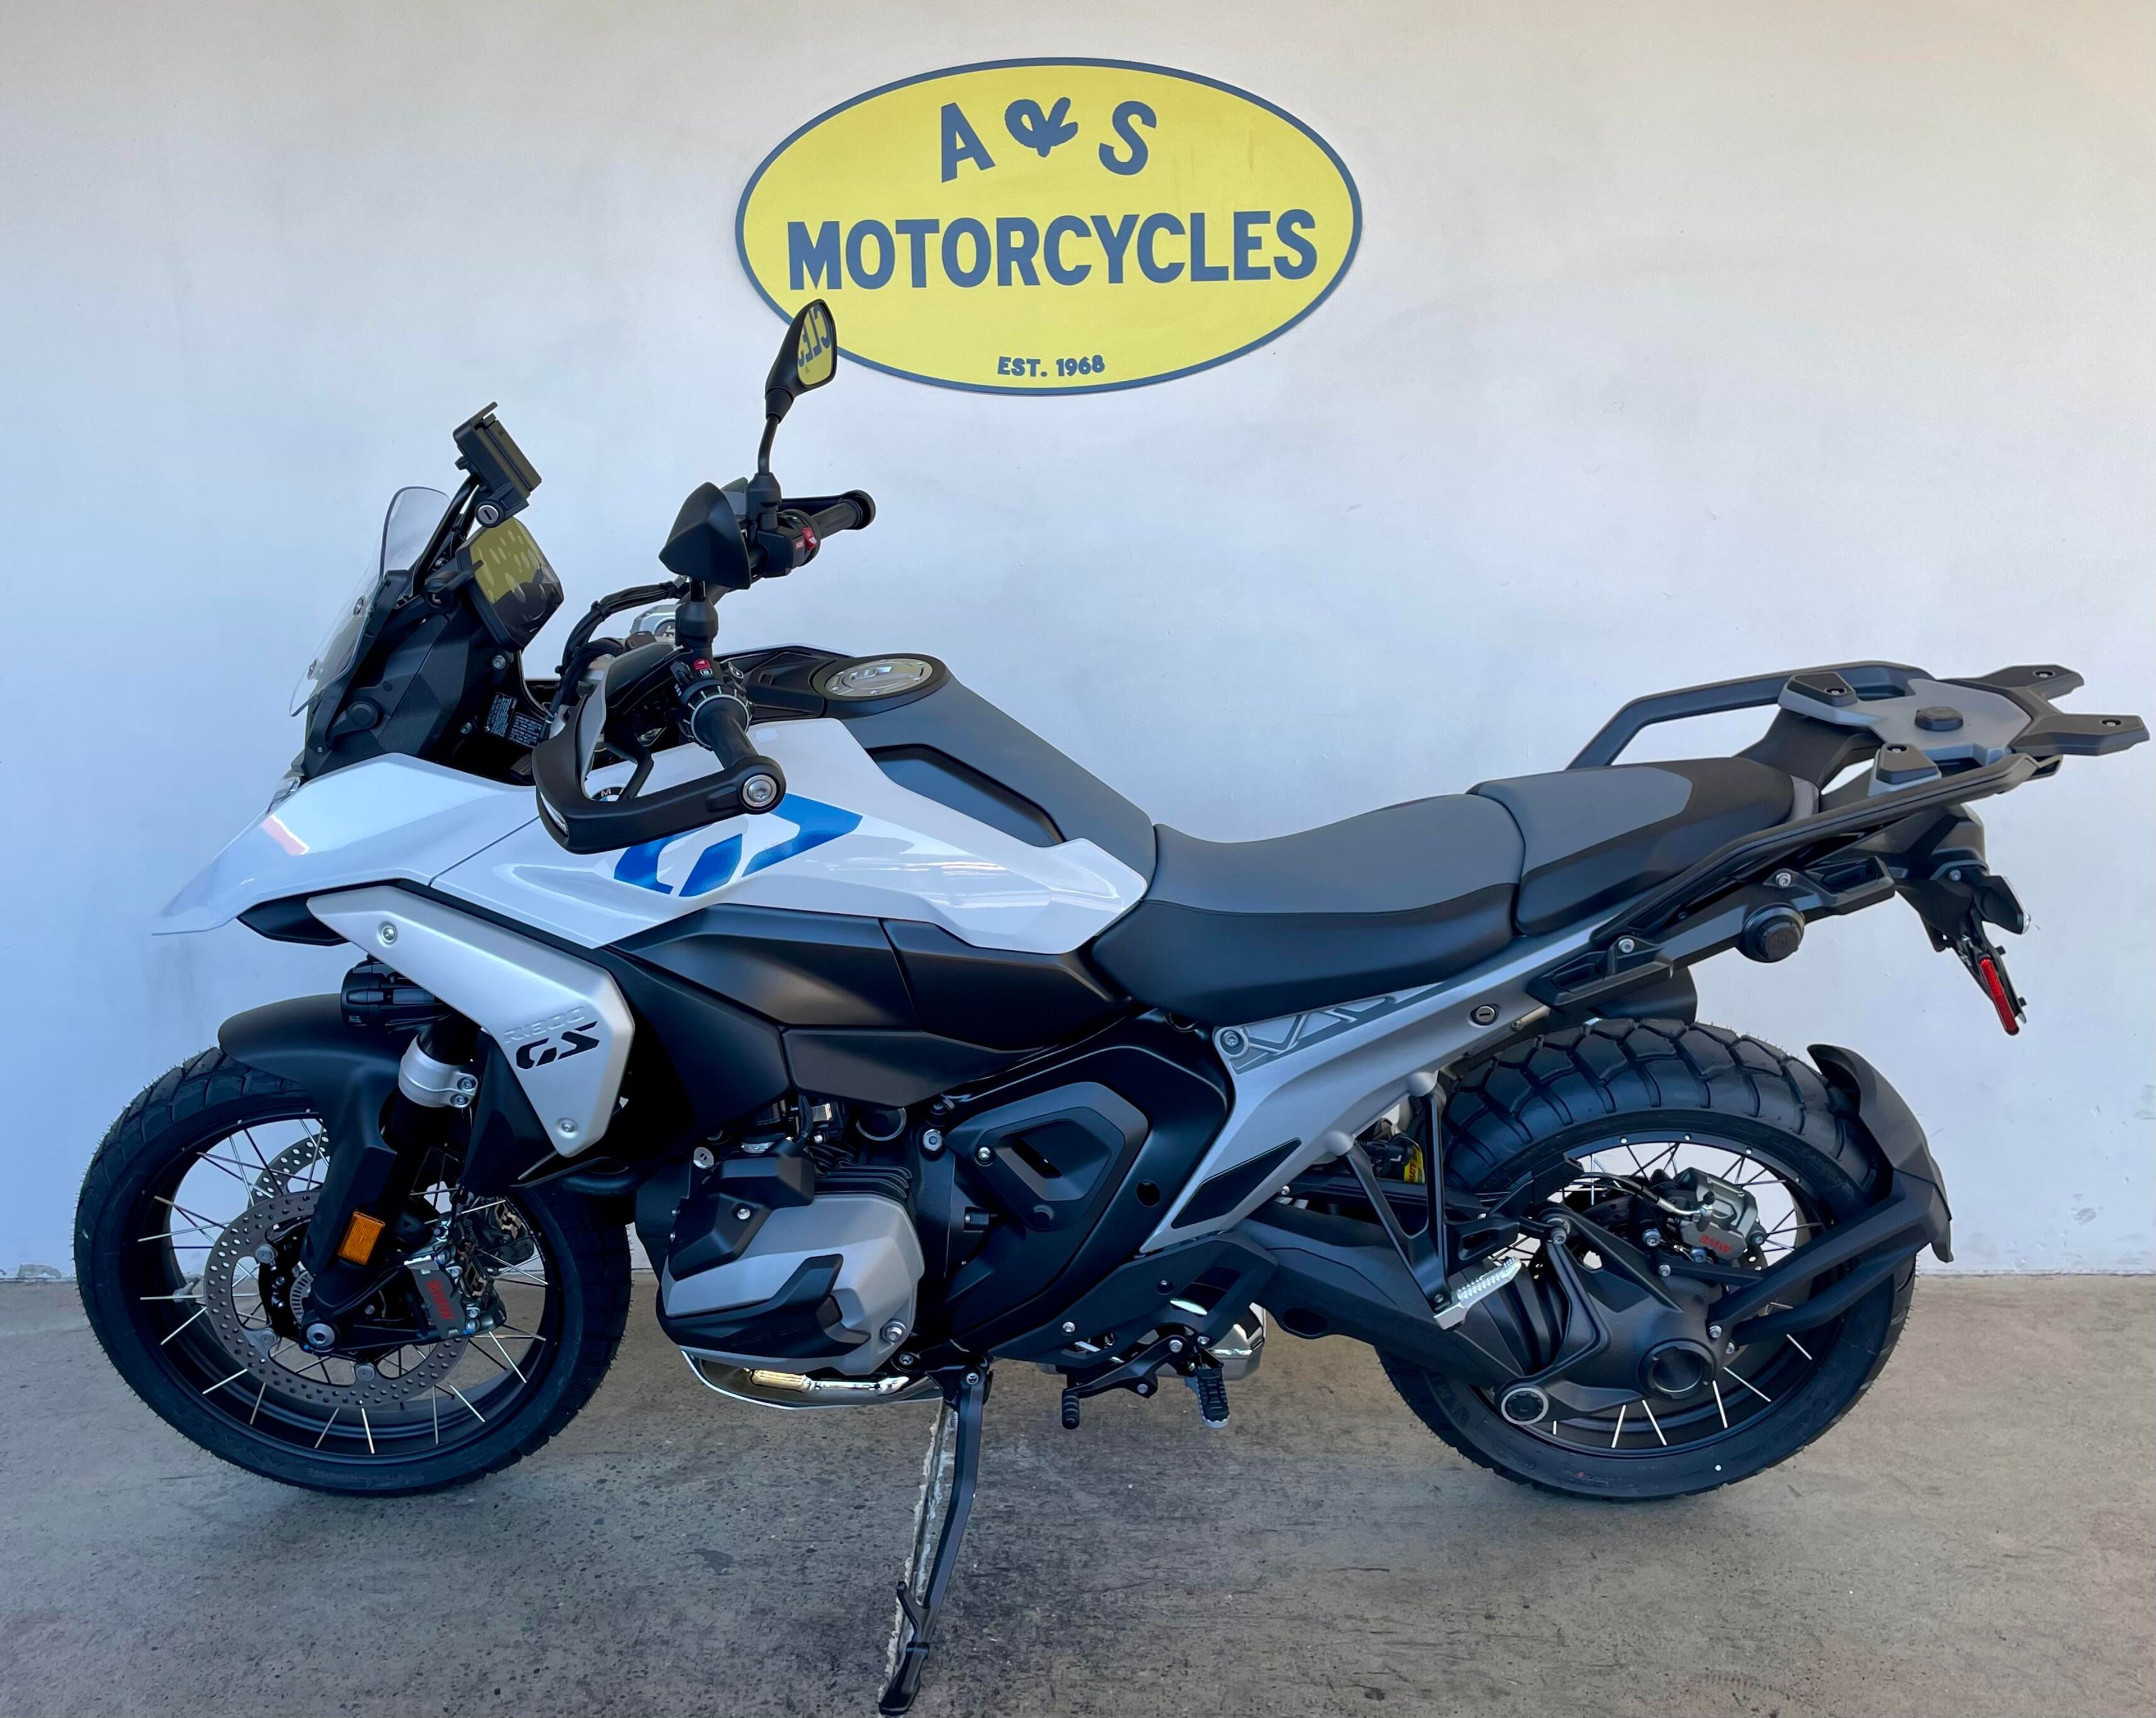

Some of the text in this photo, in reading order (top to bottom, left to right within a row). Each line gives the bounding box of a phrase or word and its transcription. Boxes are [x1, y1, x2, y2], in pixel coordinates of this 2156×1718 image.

[942, 103, 995, 182] A
[1098, 101, 1157, 175] S
[788, 209, 1317, 291] MOTORCYCLES
[997, 354, 1105, 377] EST. 1968
[516, 1020, 600, 1069] GS
